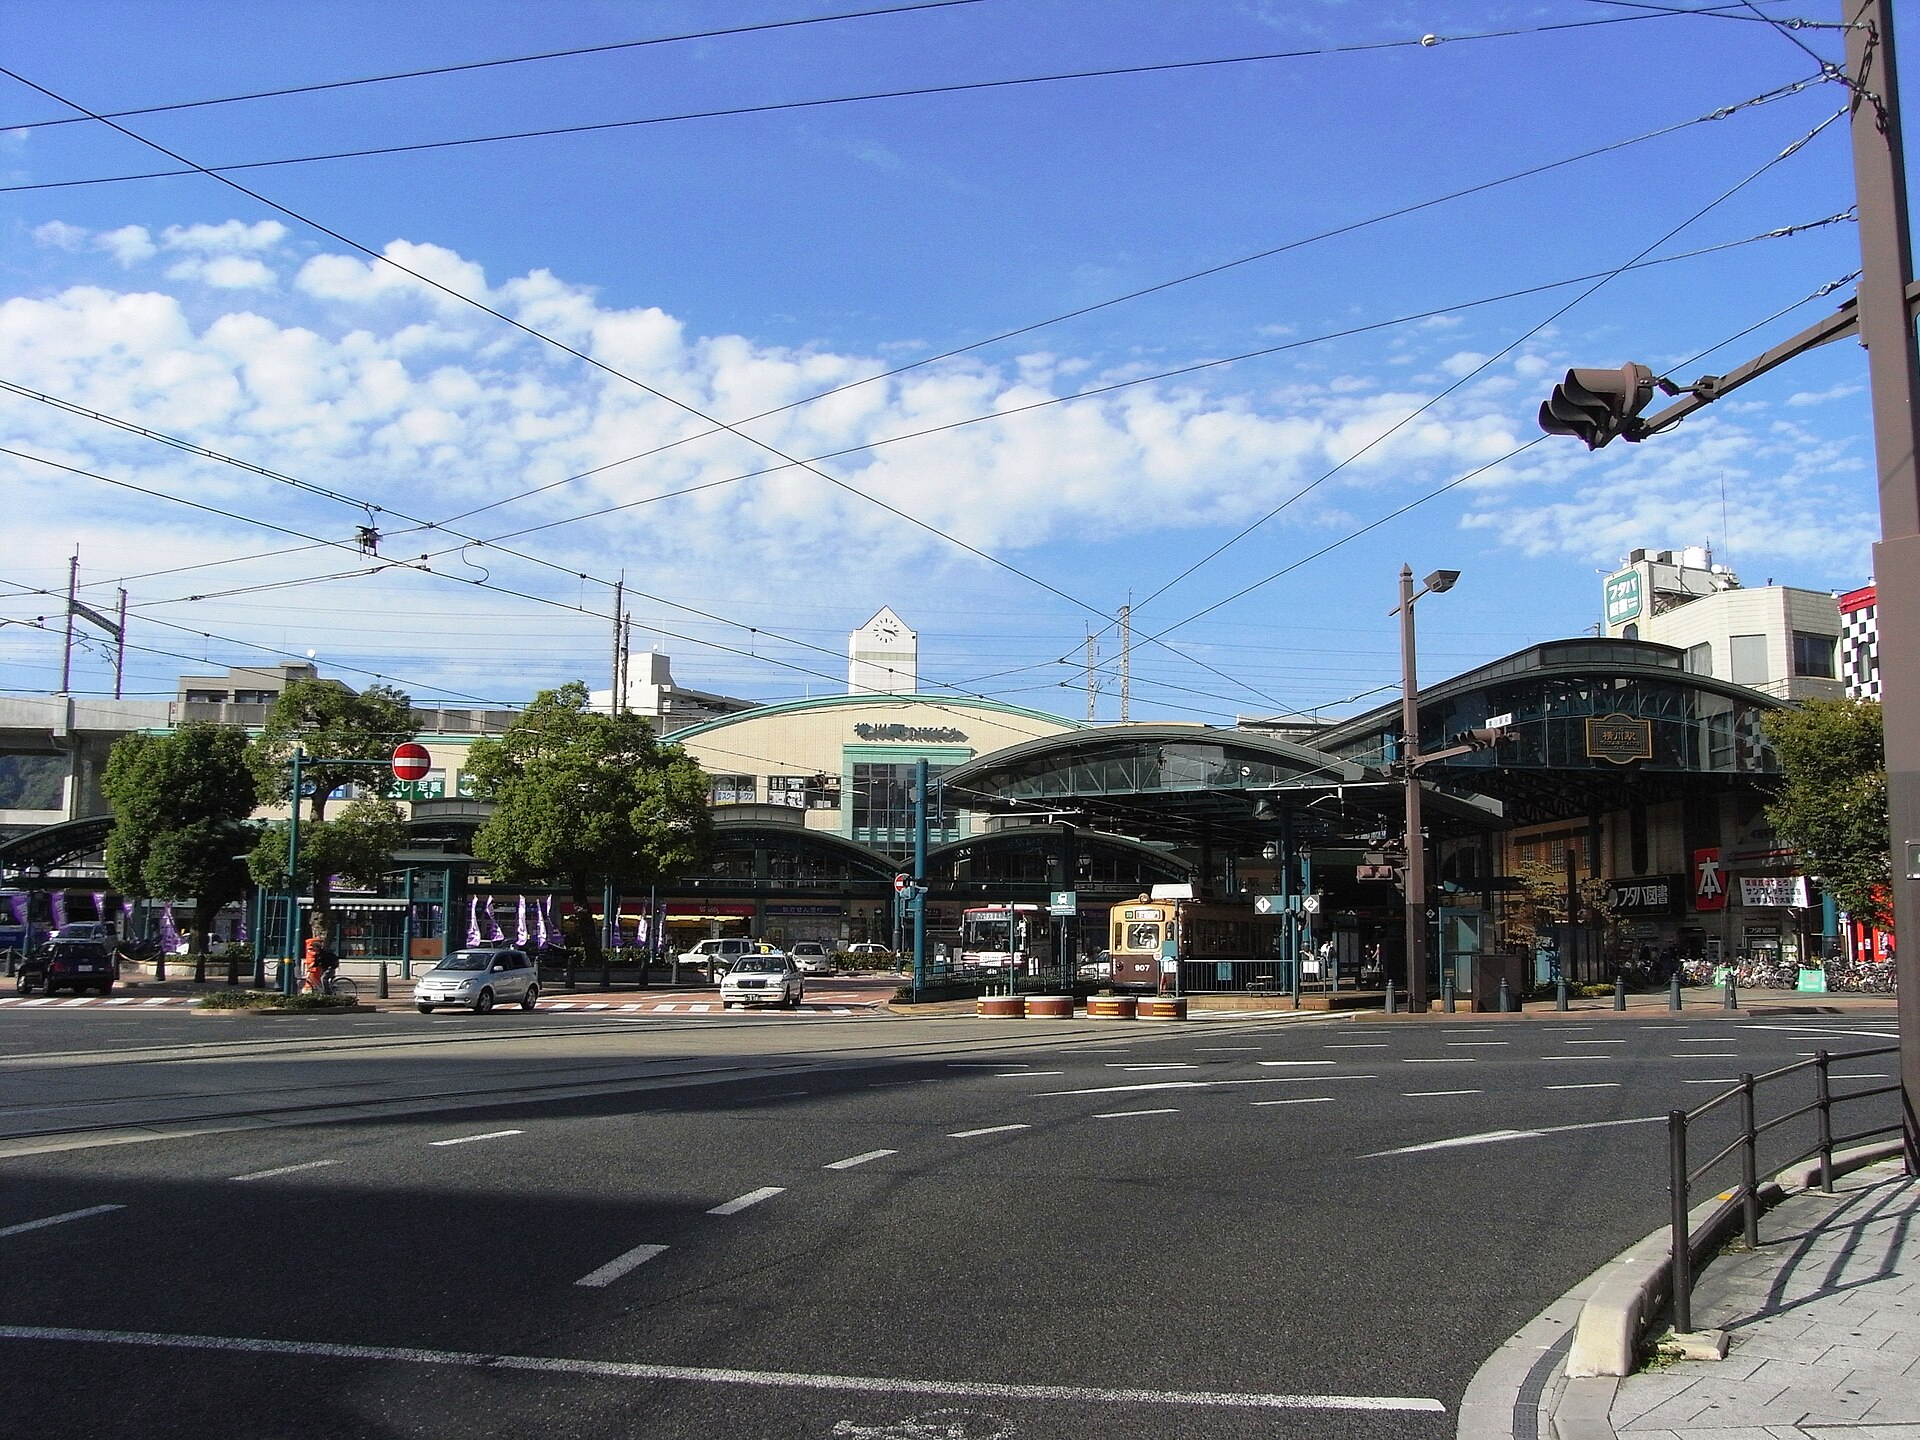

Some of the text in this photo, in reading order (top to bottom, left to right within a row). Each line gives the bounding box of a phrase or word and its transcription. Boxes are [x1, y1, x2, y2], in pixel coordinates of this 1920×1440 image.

[1608, 577, 1637, 601] フタバ
[1602, 731, 1636, 741] 横川駅
[417, 781, 442, 793] 足裏
[1697, 856, 1722, 899] 本
[1618, 884, 1668, 907] フタバ図書
[1260, 900, 1266, 909] 1
[1307, 899, 1314, 909] 2
[1134, 963, 1150, 972] 907
